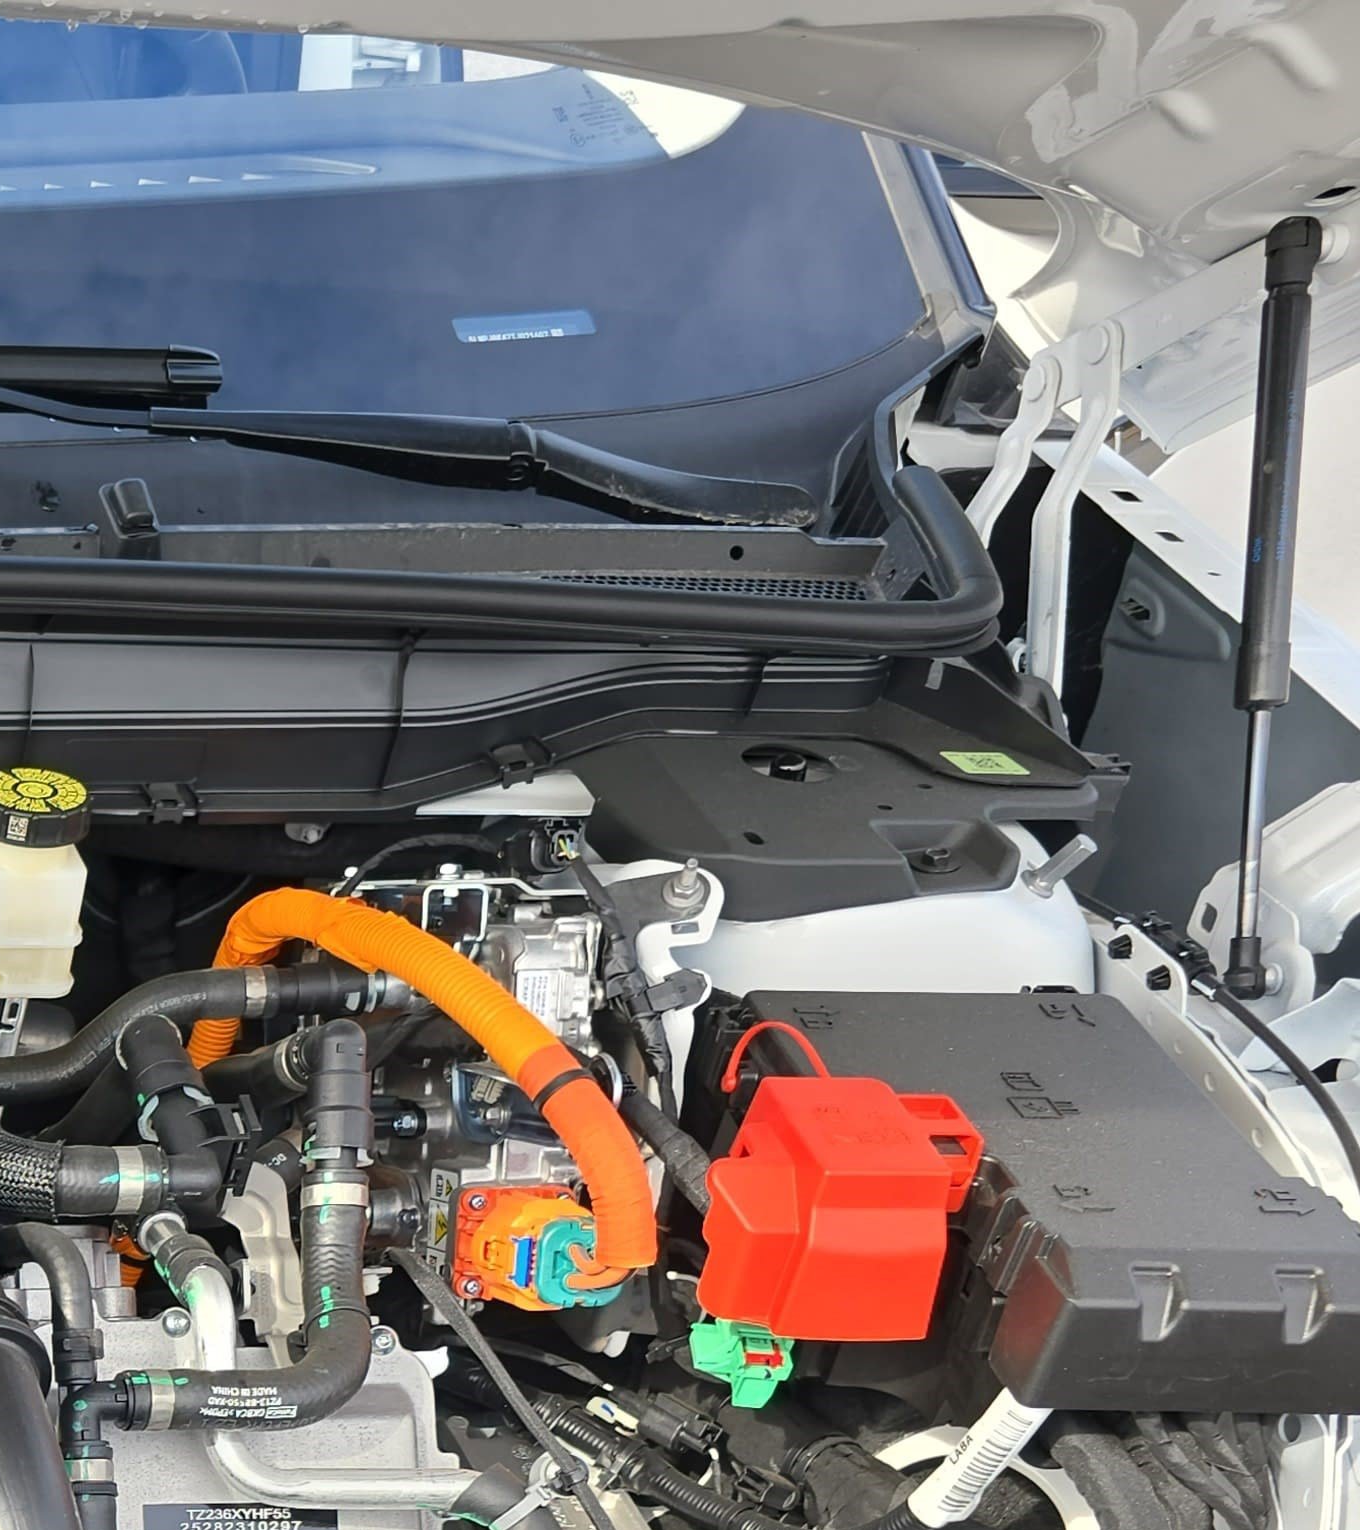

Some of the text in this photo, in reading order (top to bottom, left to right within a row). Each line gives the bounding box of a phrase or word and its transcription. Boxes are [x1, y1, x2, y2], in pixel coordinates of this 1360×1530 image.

[211, 1385, 239, 1395] CHINA
[251, 1387, 277, 1395] MADE
[186, 1508, 292, 1520] TZ236XYHF55
